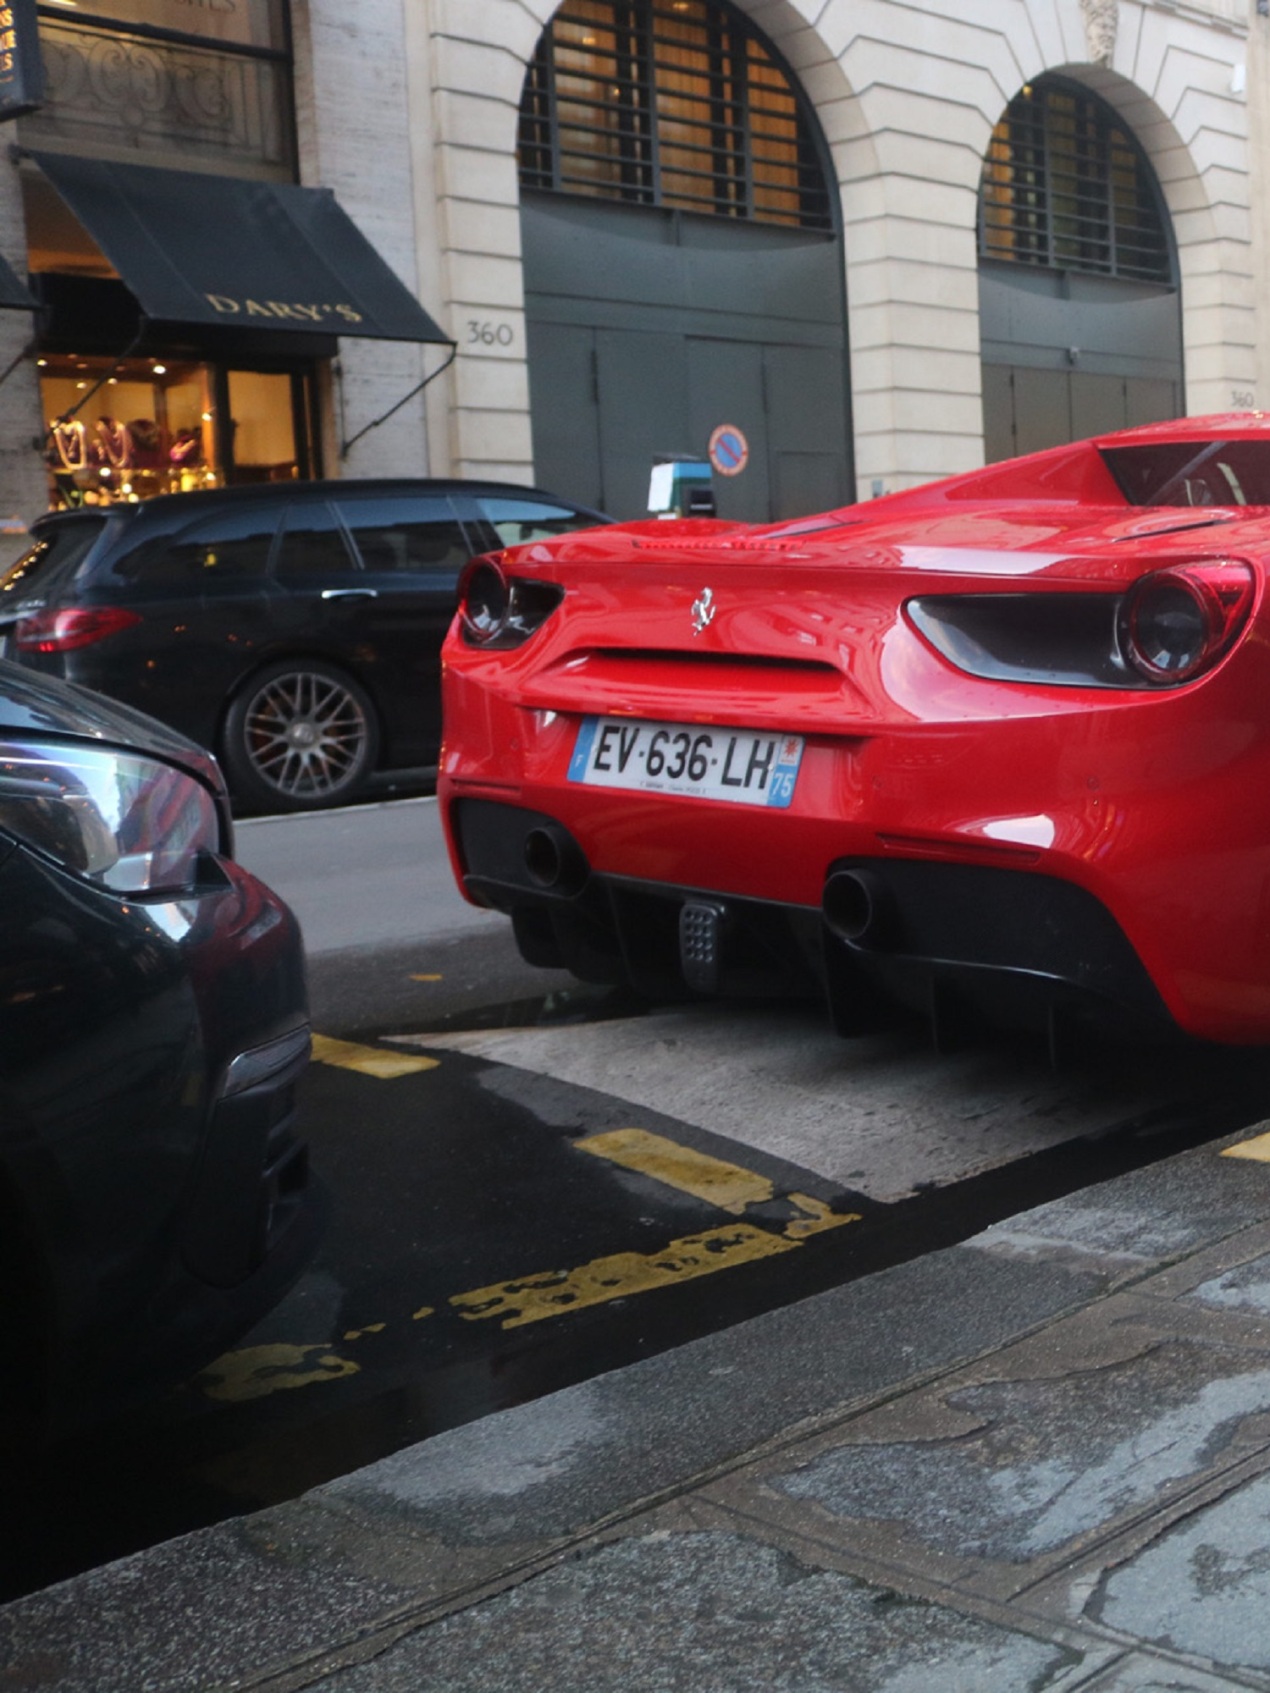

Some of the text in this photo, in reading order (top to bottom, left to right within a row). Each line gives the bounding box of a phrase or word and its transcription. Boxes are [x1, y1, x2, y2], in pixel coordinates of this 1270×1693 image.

[207, 293, 362, 323] DARY'S
[467, 320, 513, 346] 360
[772, 773, 793, 798] 75
